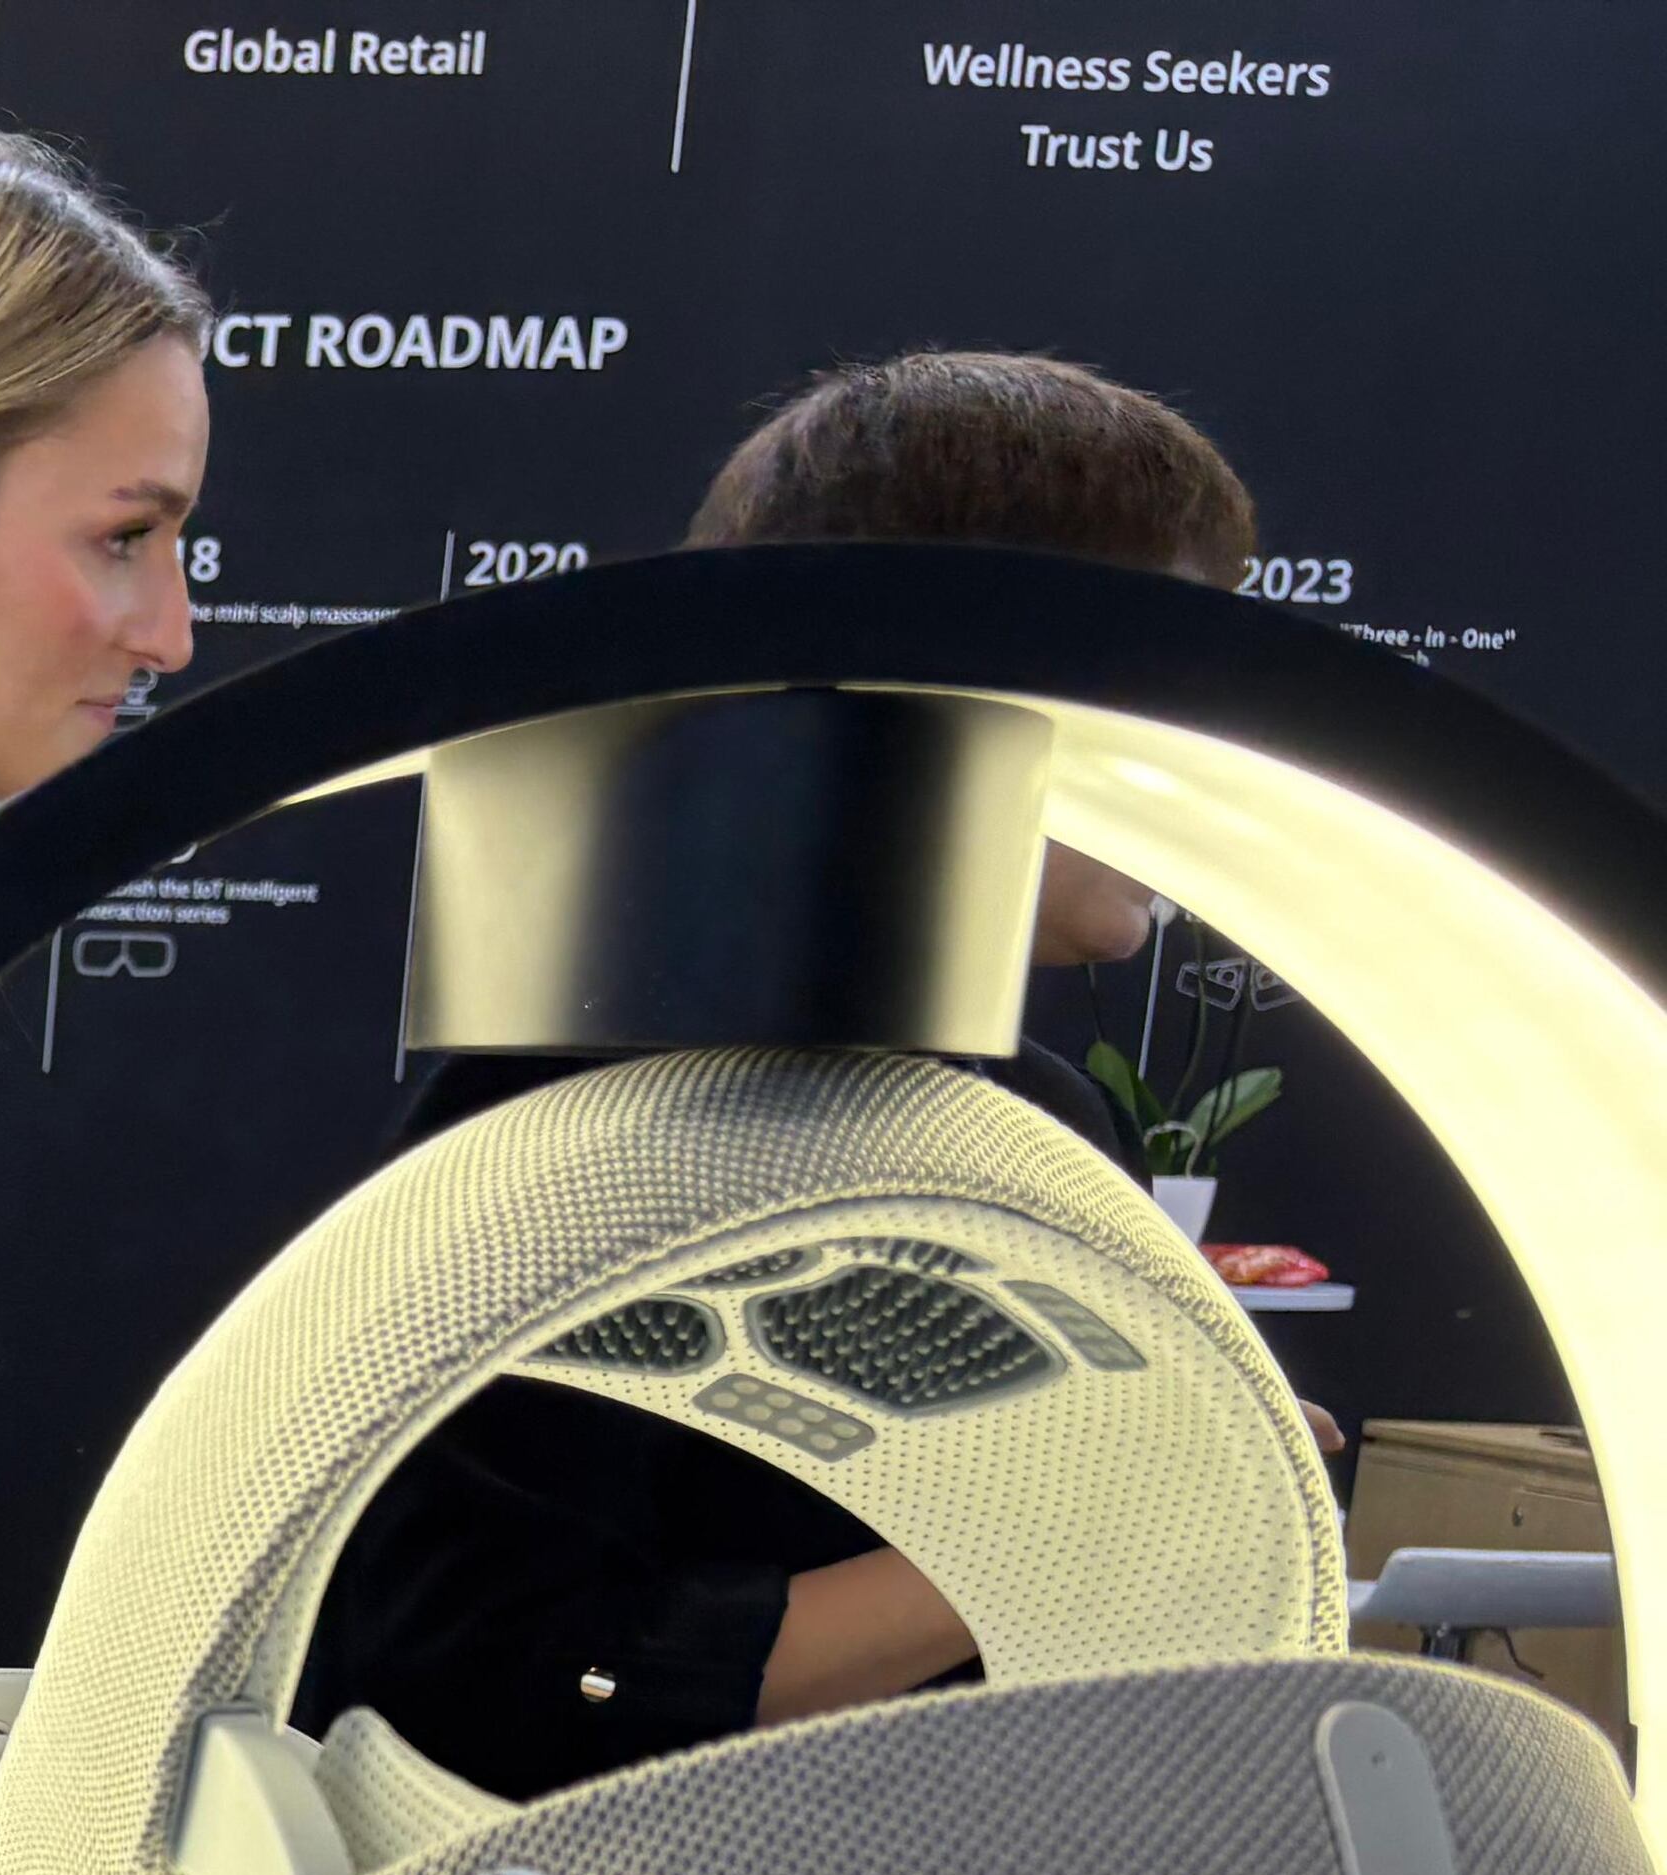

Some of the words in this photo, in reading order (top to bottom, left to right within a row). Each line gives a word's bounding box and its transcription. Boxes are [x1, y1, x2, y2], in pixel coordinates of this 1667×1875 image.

[184, 29, 336, 75] Global
[349, 31, 486, 76] Retail
[923, 42, 1131, 92] Wellness
[1142, 50, 1332, 98] Seekers
[1021, 124, 1141, 169] Trust
[1155, 129, 1214, 173] Us
[212, 314, 292, 368] CT
[305, 314, 629, 371] ROADMAP
[1233, 557, 1353, 604] 2023
[190, 602, 213, 622] he
[259, 603, 308, 629] scalp
[158, 878, 191, 901] the
[173, 906, 231, 925] series
